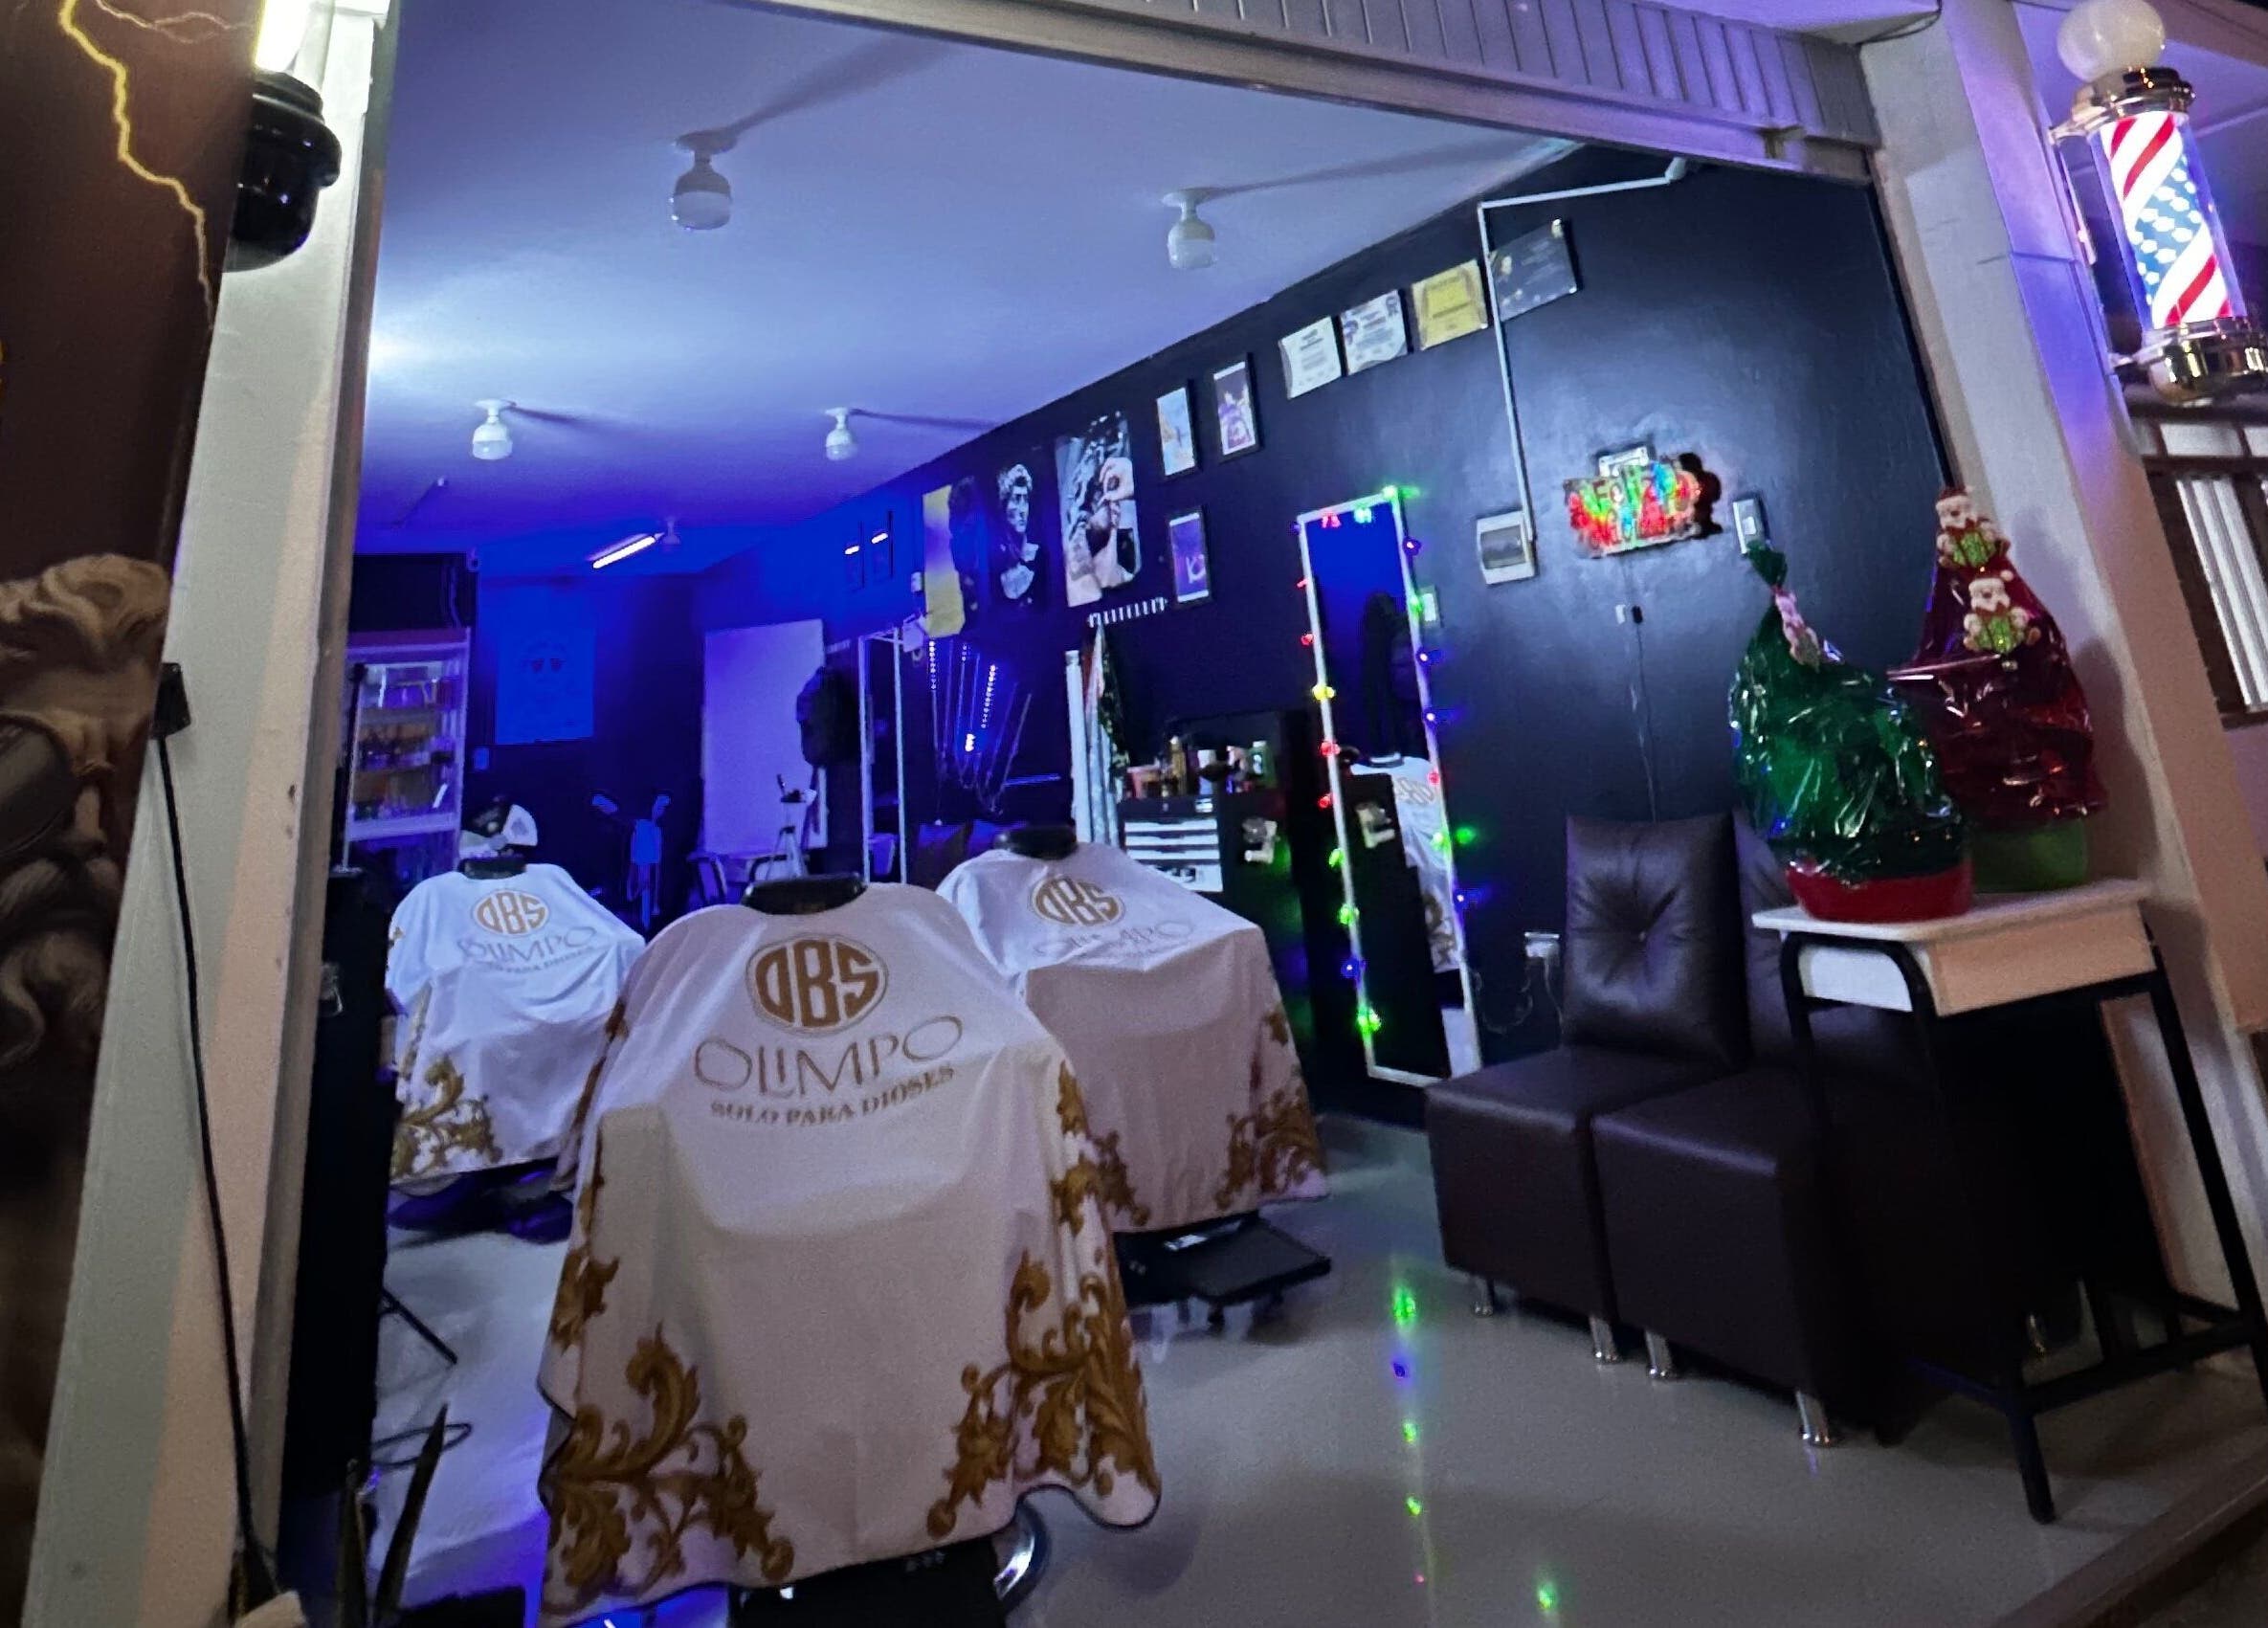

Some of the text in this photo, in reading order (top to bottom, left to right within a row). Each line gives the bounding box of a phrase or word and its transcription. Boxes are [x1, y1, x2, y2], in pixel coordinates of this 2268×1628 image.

[476, 891, 546, 935] OBS
[754, 939, 879, 1028] OBS
[695, 1015, 964, 1099] OLIMPO
[710, 1062, 956, 1126] SOLO PARA DIOSES
